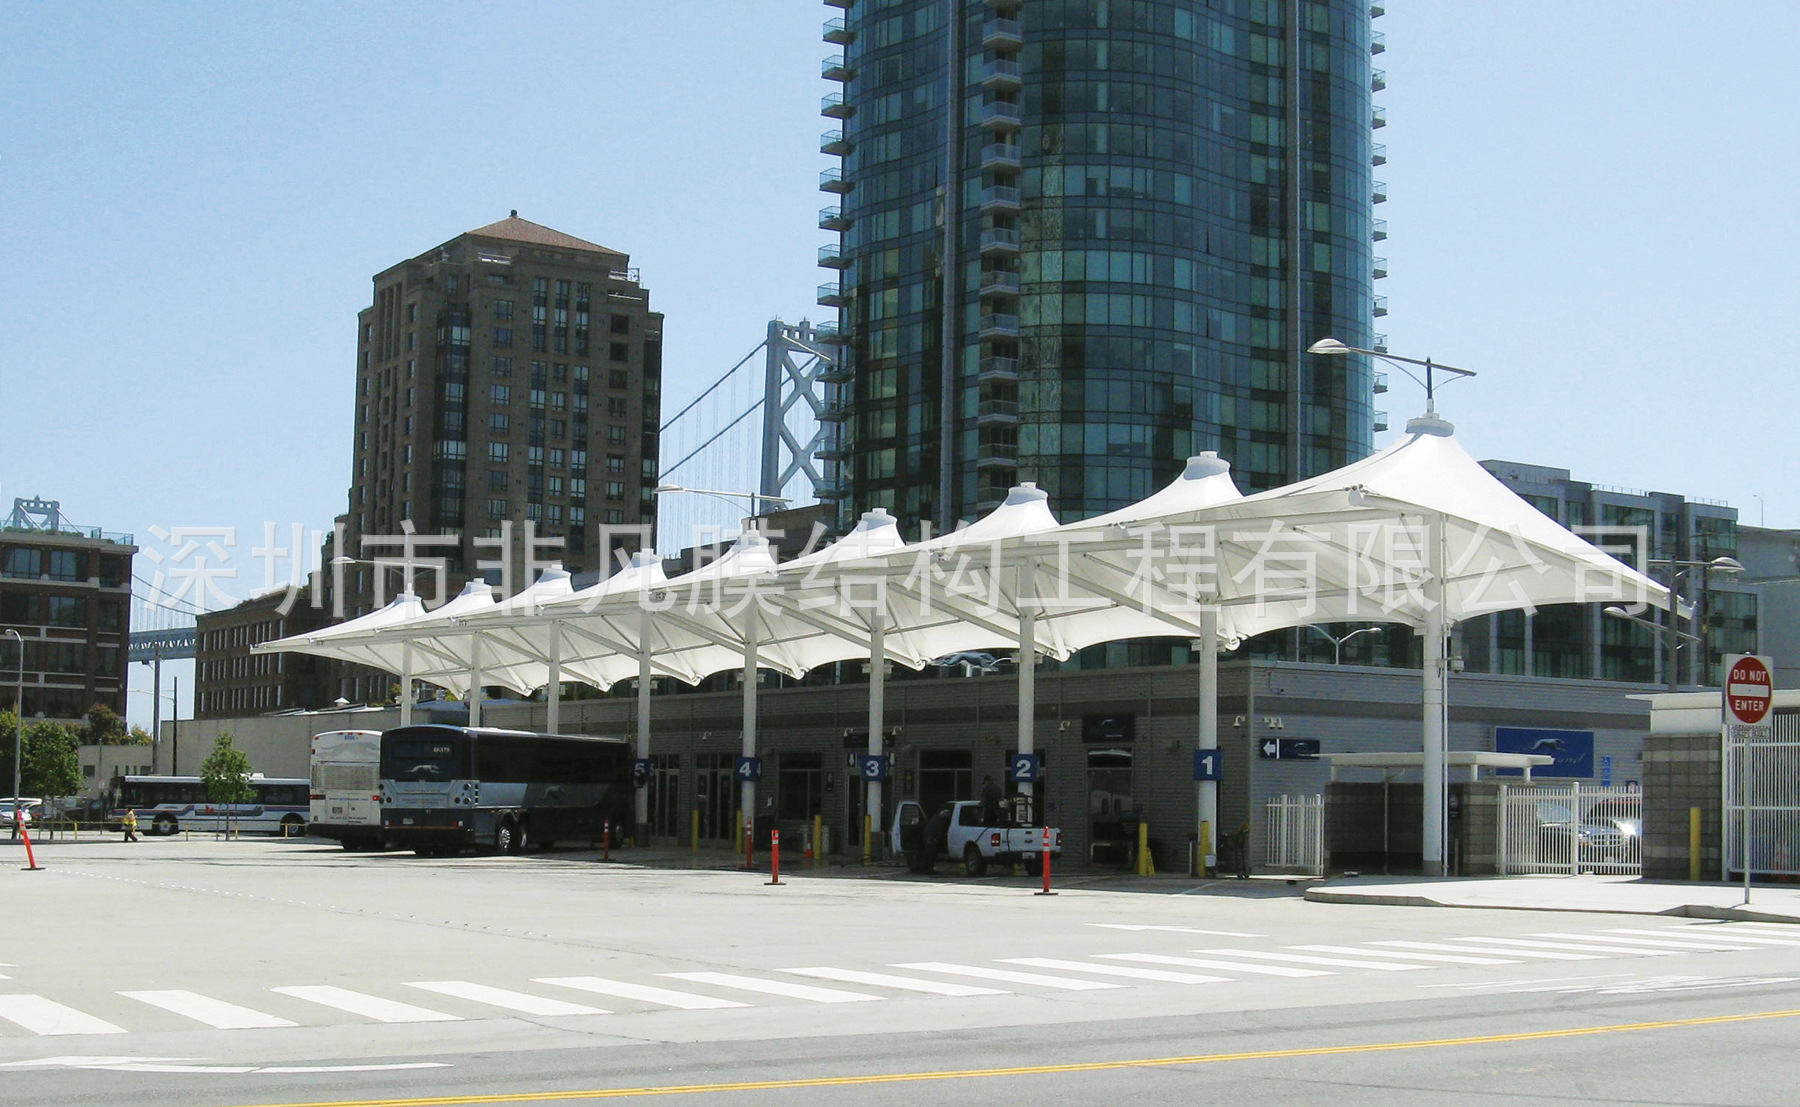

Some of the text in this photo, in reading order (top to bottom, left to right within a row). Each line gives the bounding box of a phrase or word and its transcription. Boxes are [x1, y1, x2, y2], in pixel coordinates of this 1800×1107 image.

[1733, 669, 1767, 682] DO NOT
[1735, 699, 1765, 712] ENTER
[634, 763, 645, 776] 5
[739, 761, 752, 776] 4
[865, 760, 880, 777] 3
[1015, 759, 1032, 778] 2
[1202, 755, 1213, 775] 1
